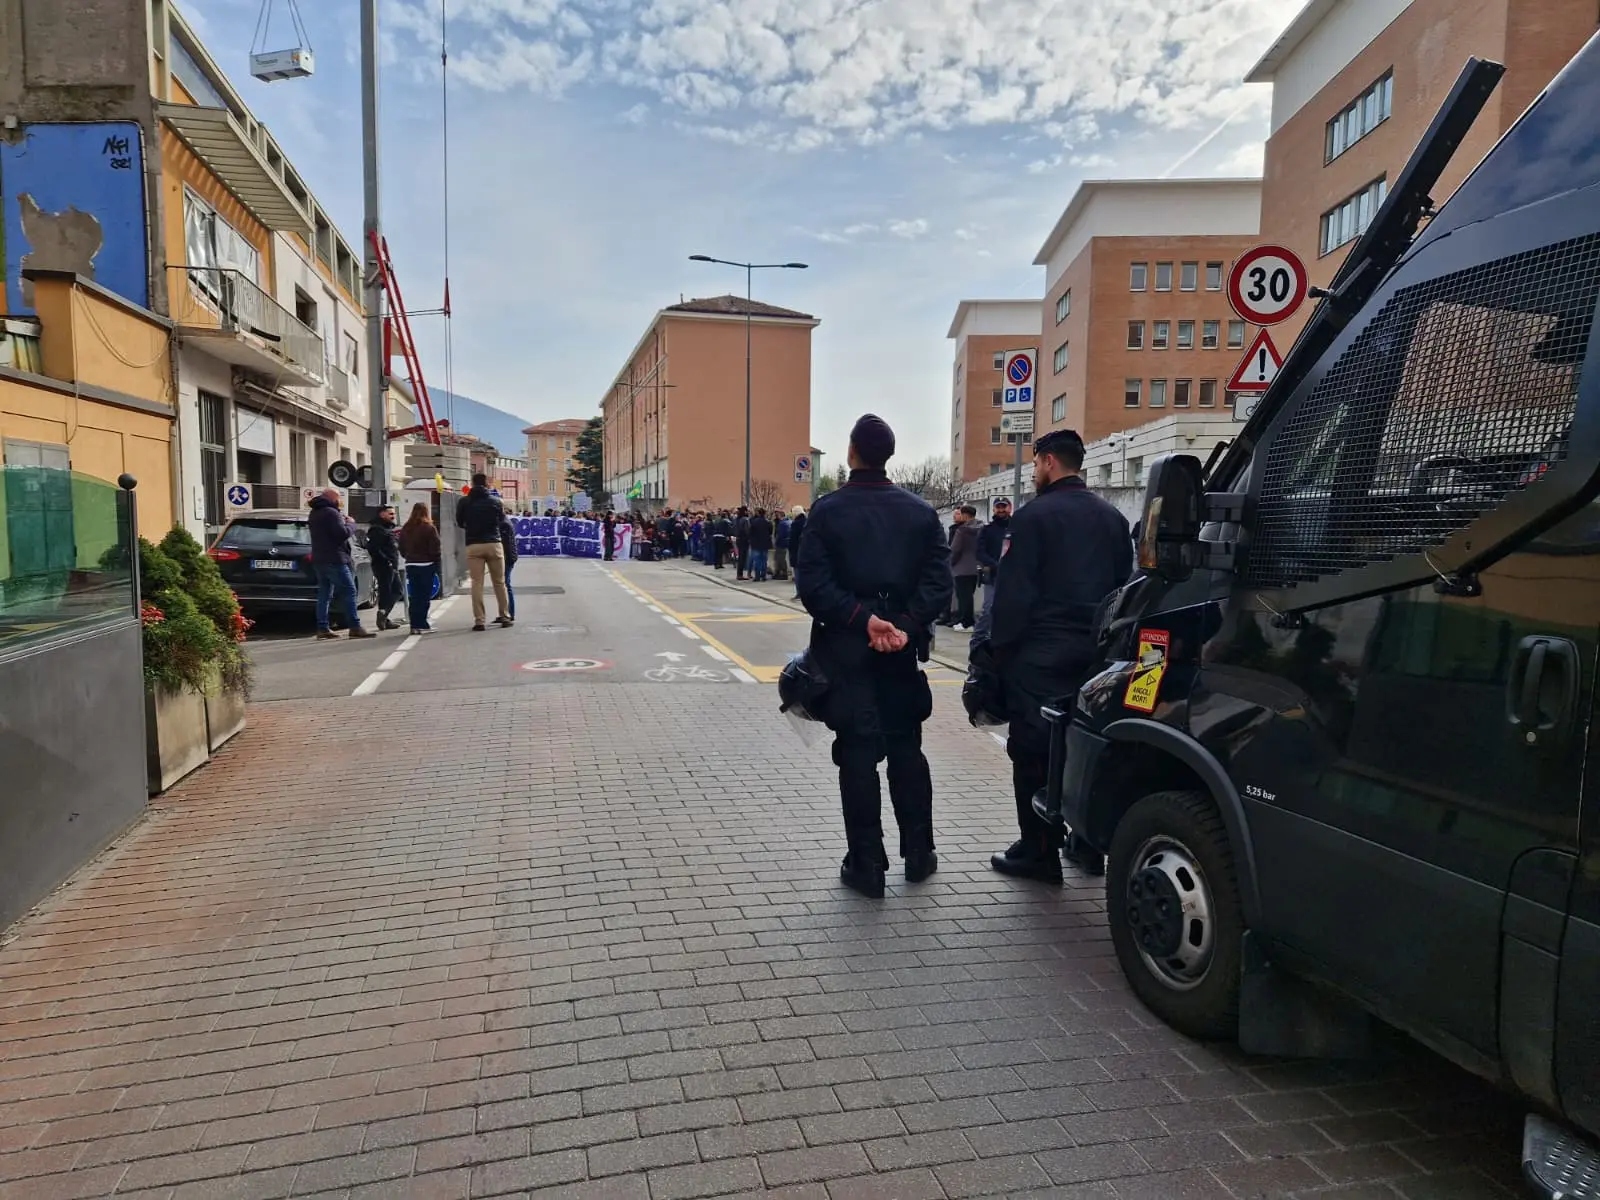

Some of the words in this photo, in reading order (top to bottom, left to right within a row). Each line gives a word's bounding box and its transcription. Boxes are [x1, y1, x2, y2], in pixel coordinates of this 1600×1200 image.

[1248, 267, 1290, 302] 30
[1133, 686, 1152, 696] ANGOLI
[1131, 694, 1148, 704] MORTI
[1246, 785, 1262, 797] 5,25
[1262, 789, 1276, 801] bar
